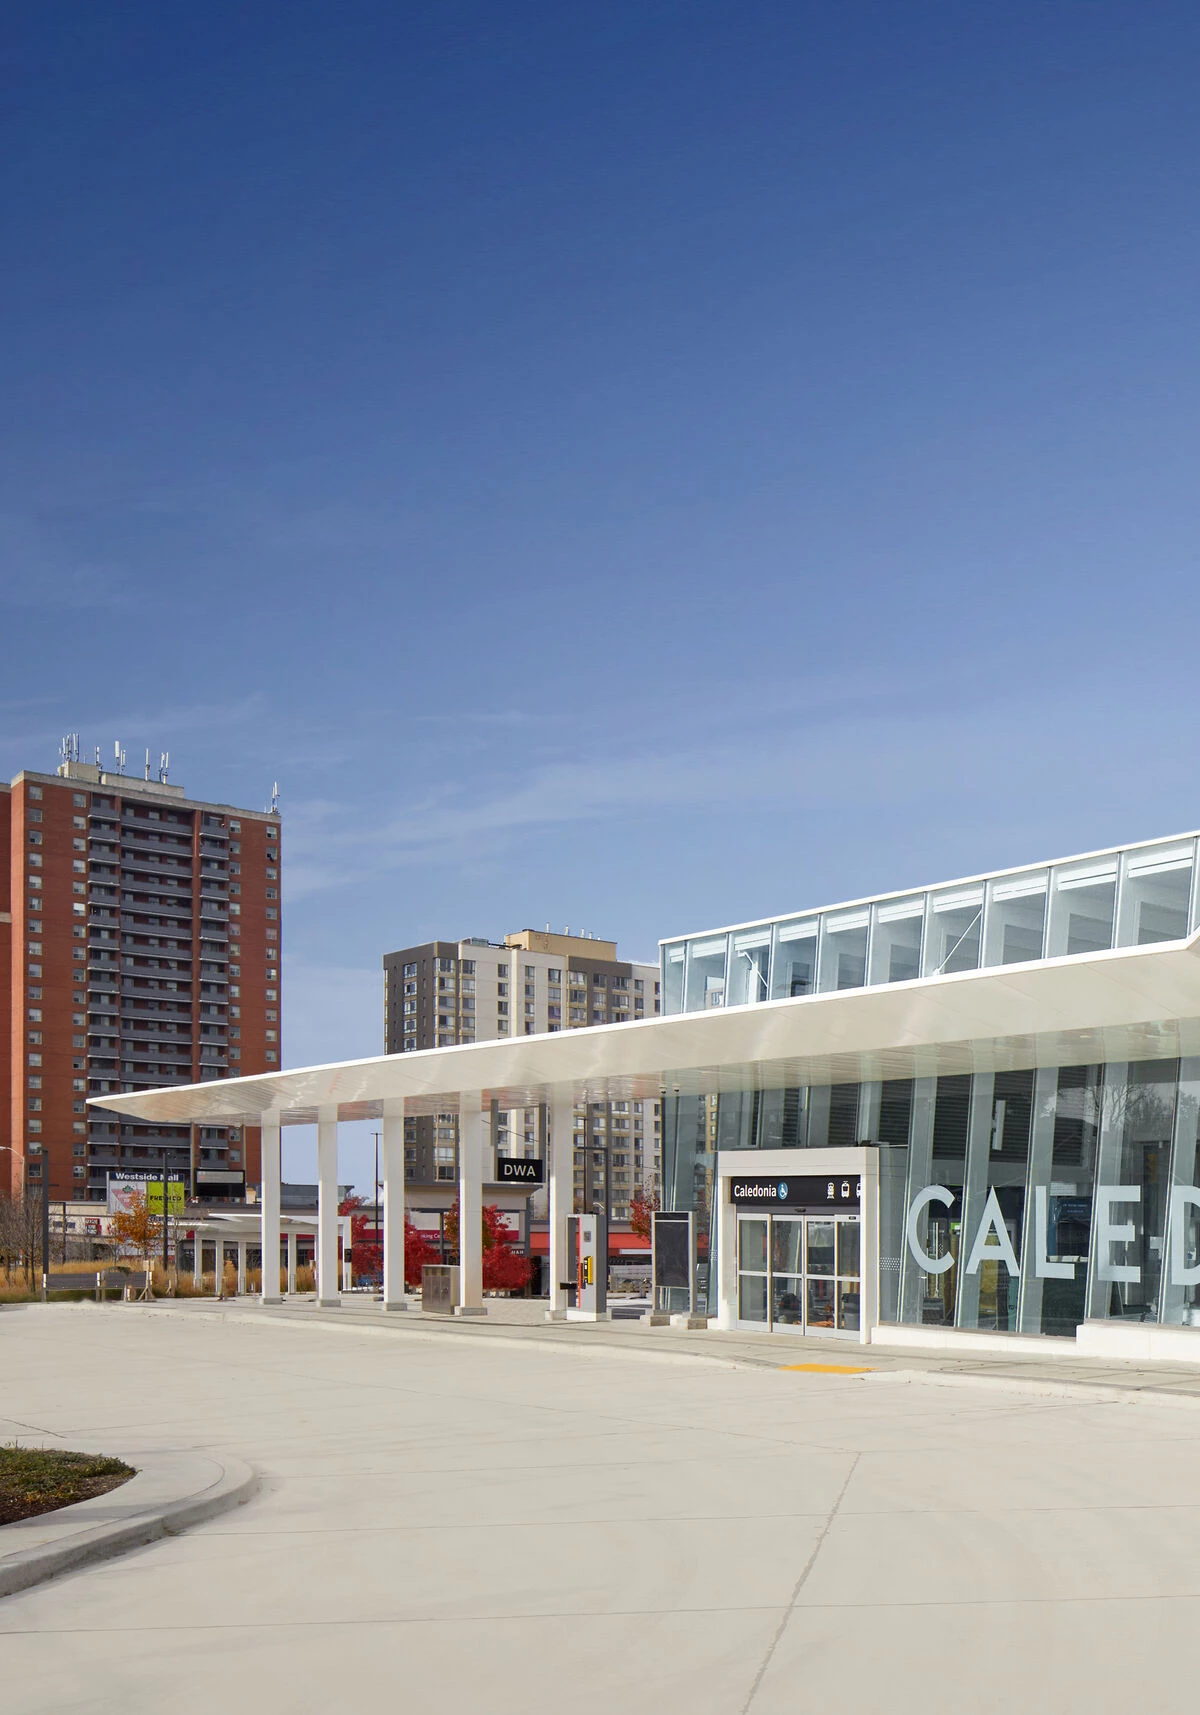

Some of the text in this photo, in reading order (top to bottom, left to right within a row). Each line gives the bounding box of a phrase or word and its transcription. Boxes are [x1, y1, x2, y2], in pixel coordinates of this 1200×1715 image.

[115, 1172, 158, 1181] Westside
[504, 1164, 536, 1177] DWA
[734, 1184, 777, 1198] Caledonia
